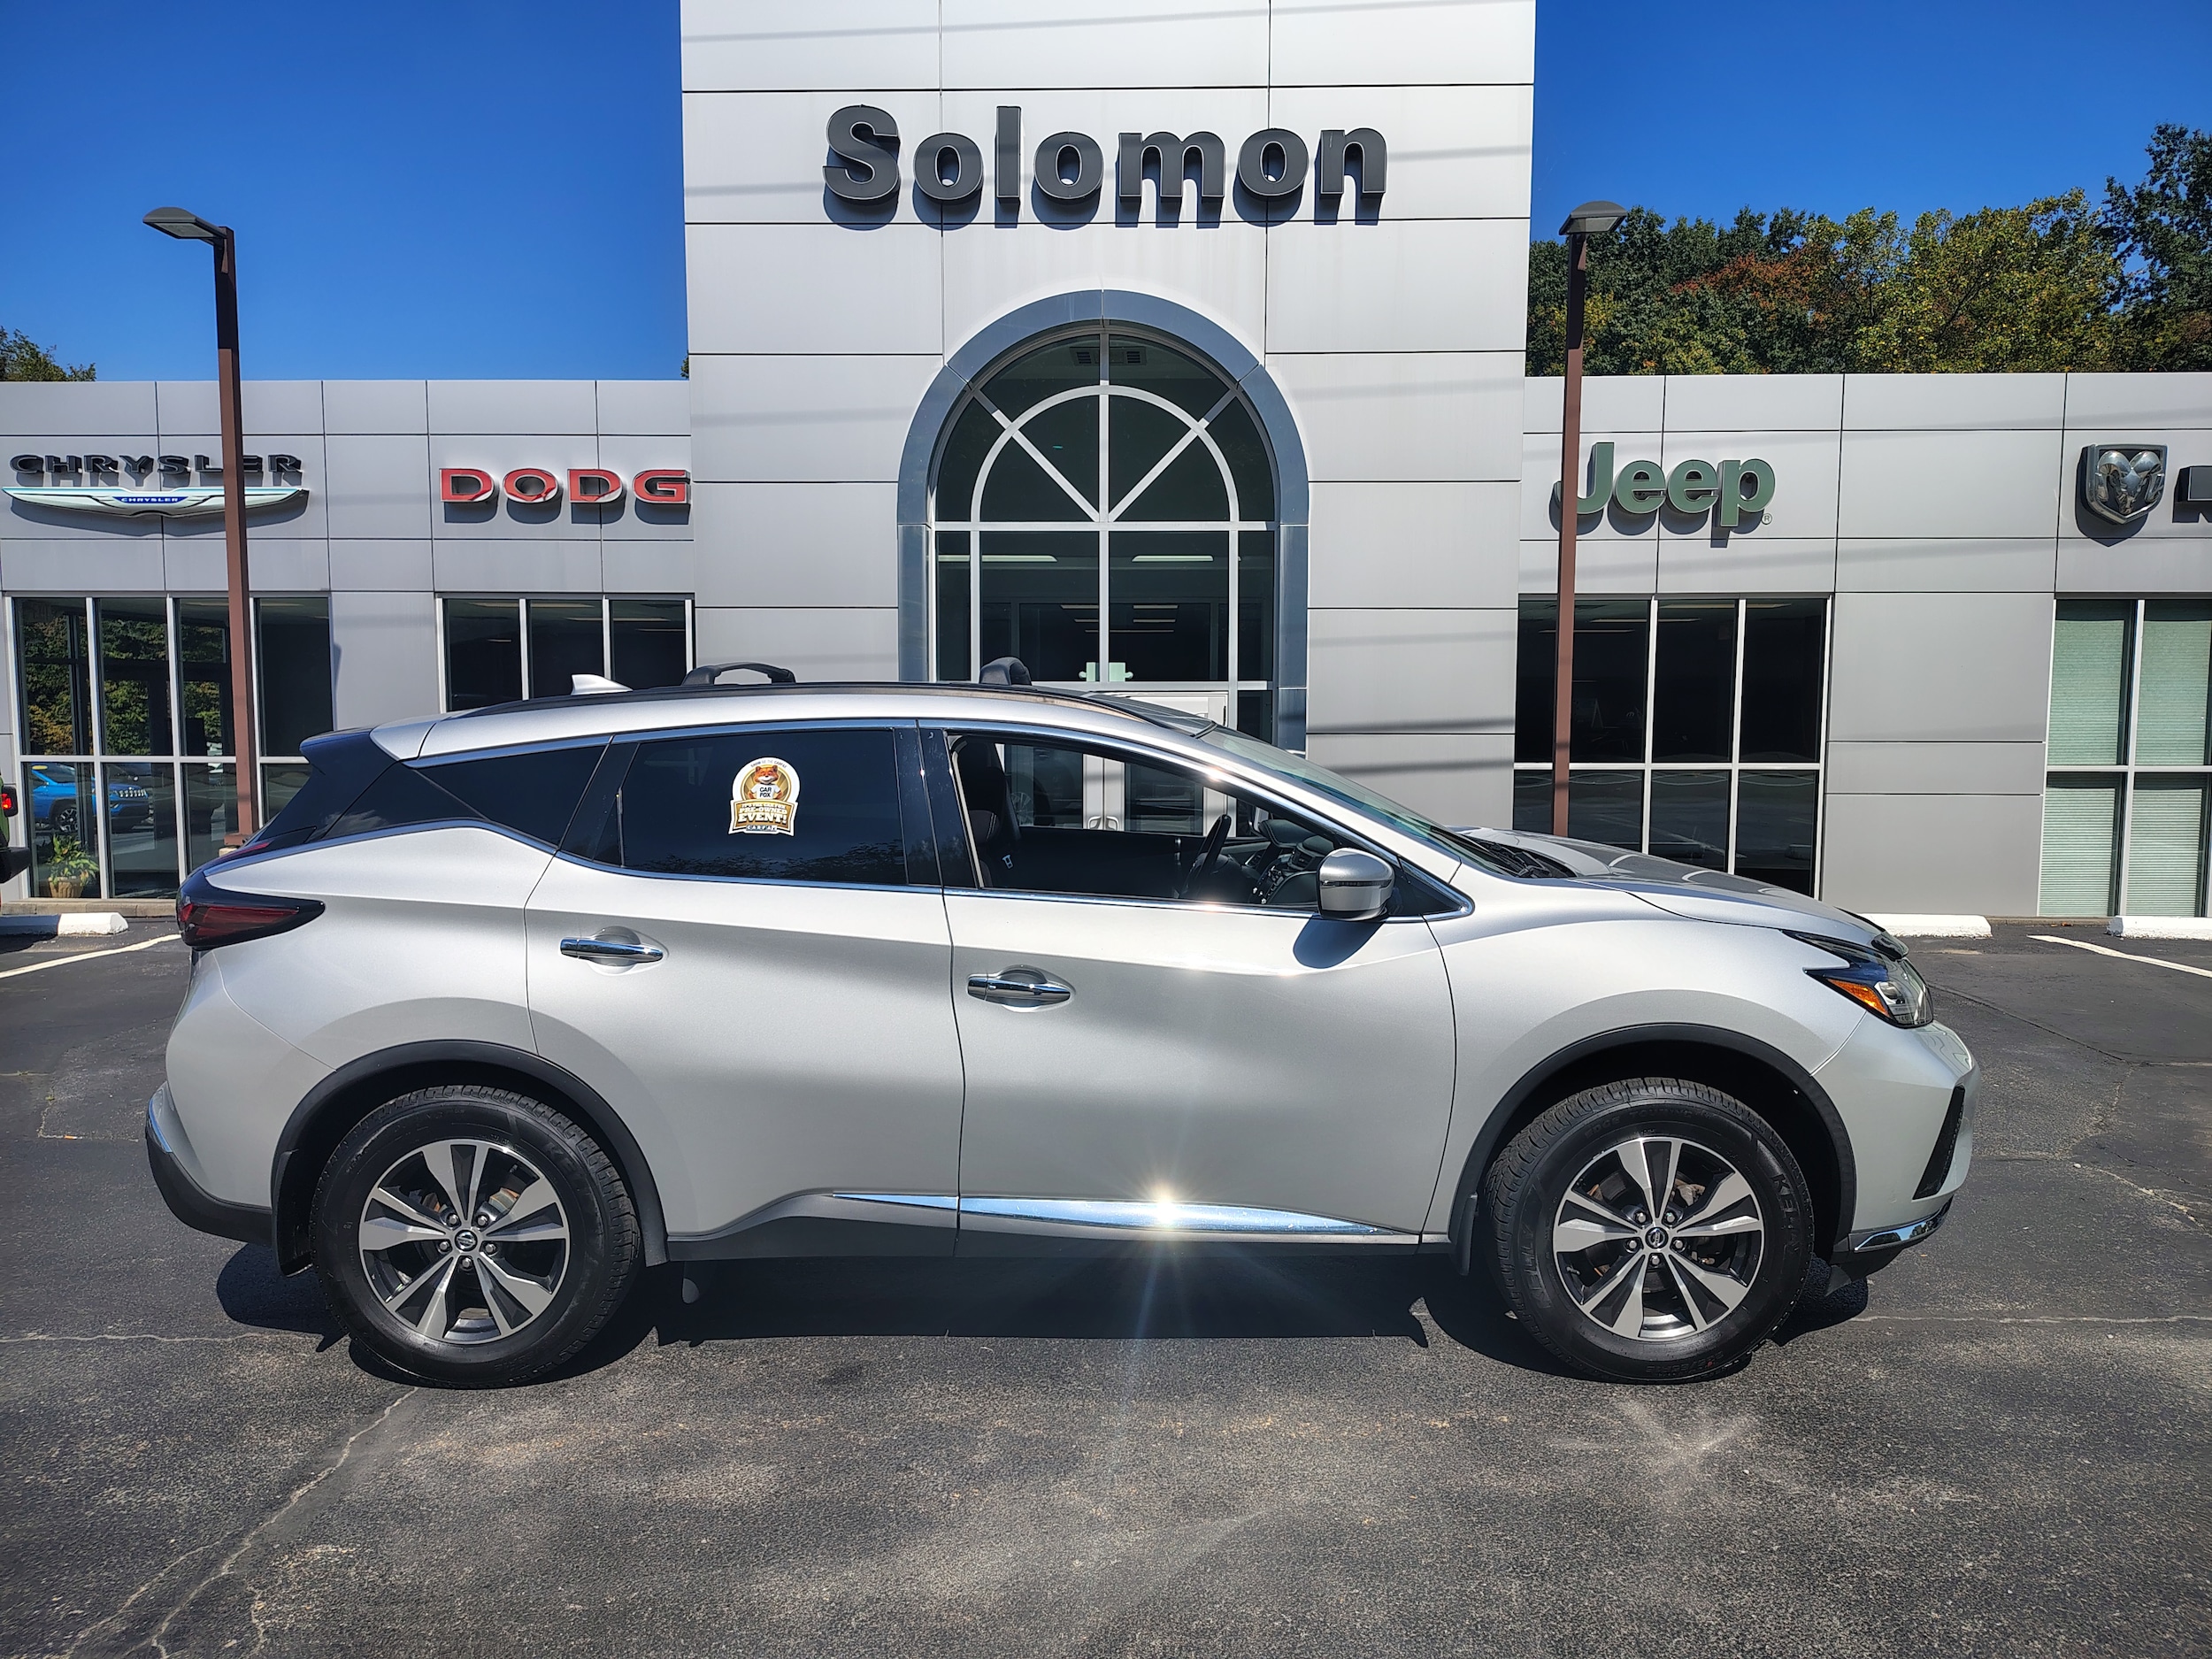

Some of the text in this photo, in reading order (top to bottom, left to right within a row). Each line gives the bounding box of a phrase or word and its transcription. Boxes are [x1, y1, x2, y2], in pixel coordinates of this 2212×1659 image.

[822, 104, 1387, 202] Solomon
[1553, 442, 1776, 527] Jeep
[738, 812, 788, 825] EVENT!
